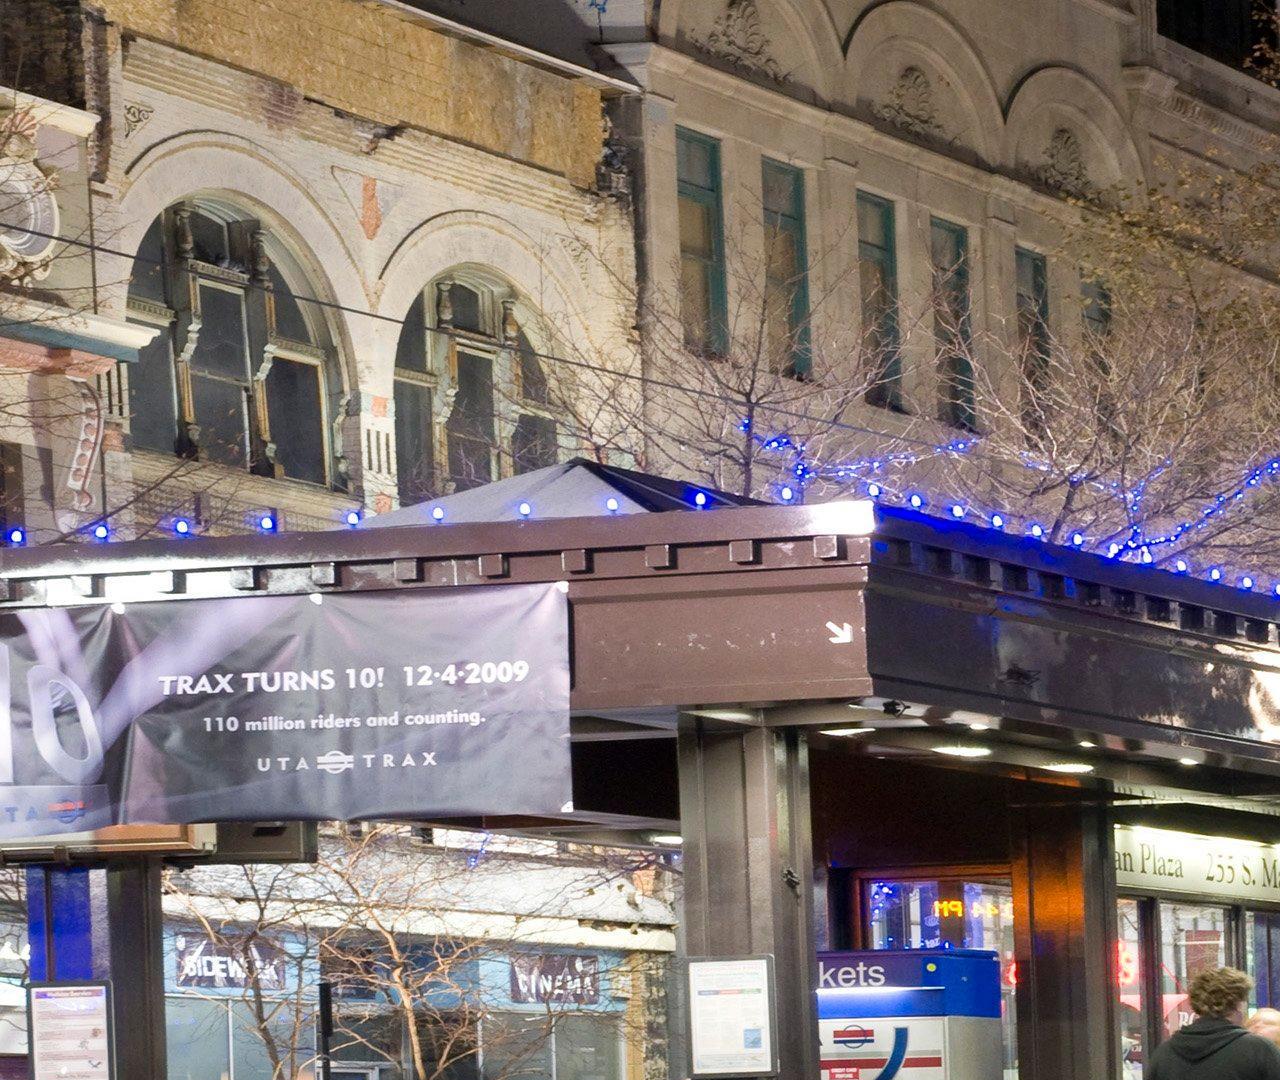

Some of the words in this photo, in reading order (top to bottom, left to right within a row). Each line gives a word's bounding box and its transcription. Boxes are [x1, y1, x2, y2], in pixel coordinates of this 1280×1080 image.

[159, 673, 234, 695] TRAX
[242, 669, 335, 692] TURNS
[347, 667, 384, 688] 10!
[203, 717, 239, 732] 110
[245, 714, 305, 731] million
[311, 714, 360, 729] riders
[367, 712, 399, 727] and
[404, 709, 486, 730] counting.
[257, 757, 309, 772] UTA
[363, 752, 437, 768] TRAX
[1140, 843, 1183, 878] Plaza
[1206, 852, 1235, 883] 255
[517, 971, 595, 996] CINEMA
[818, 962, 885, 987] kets
